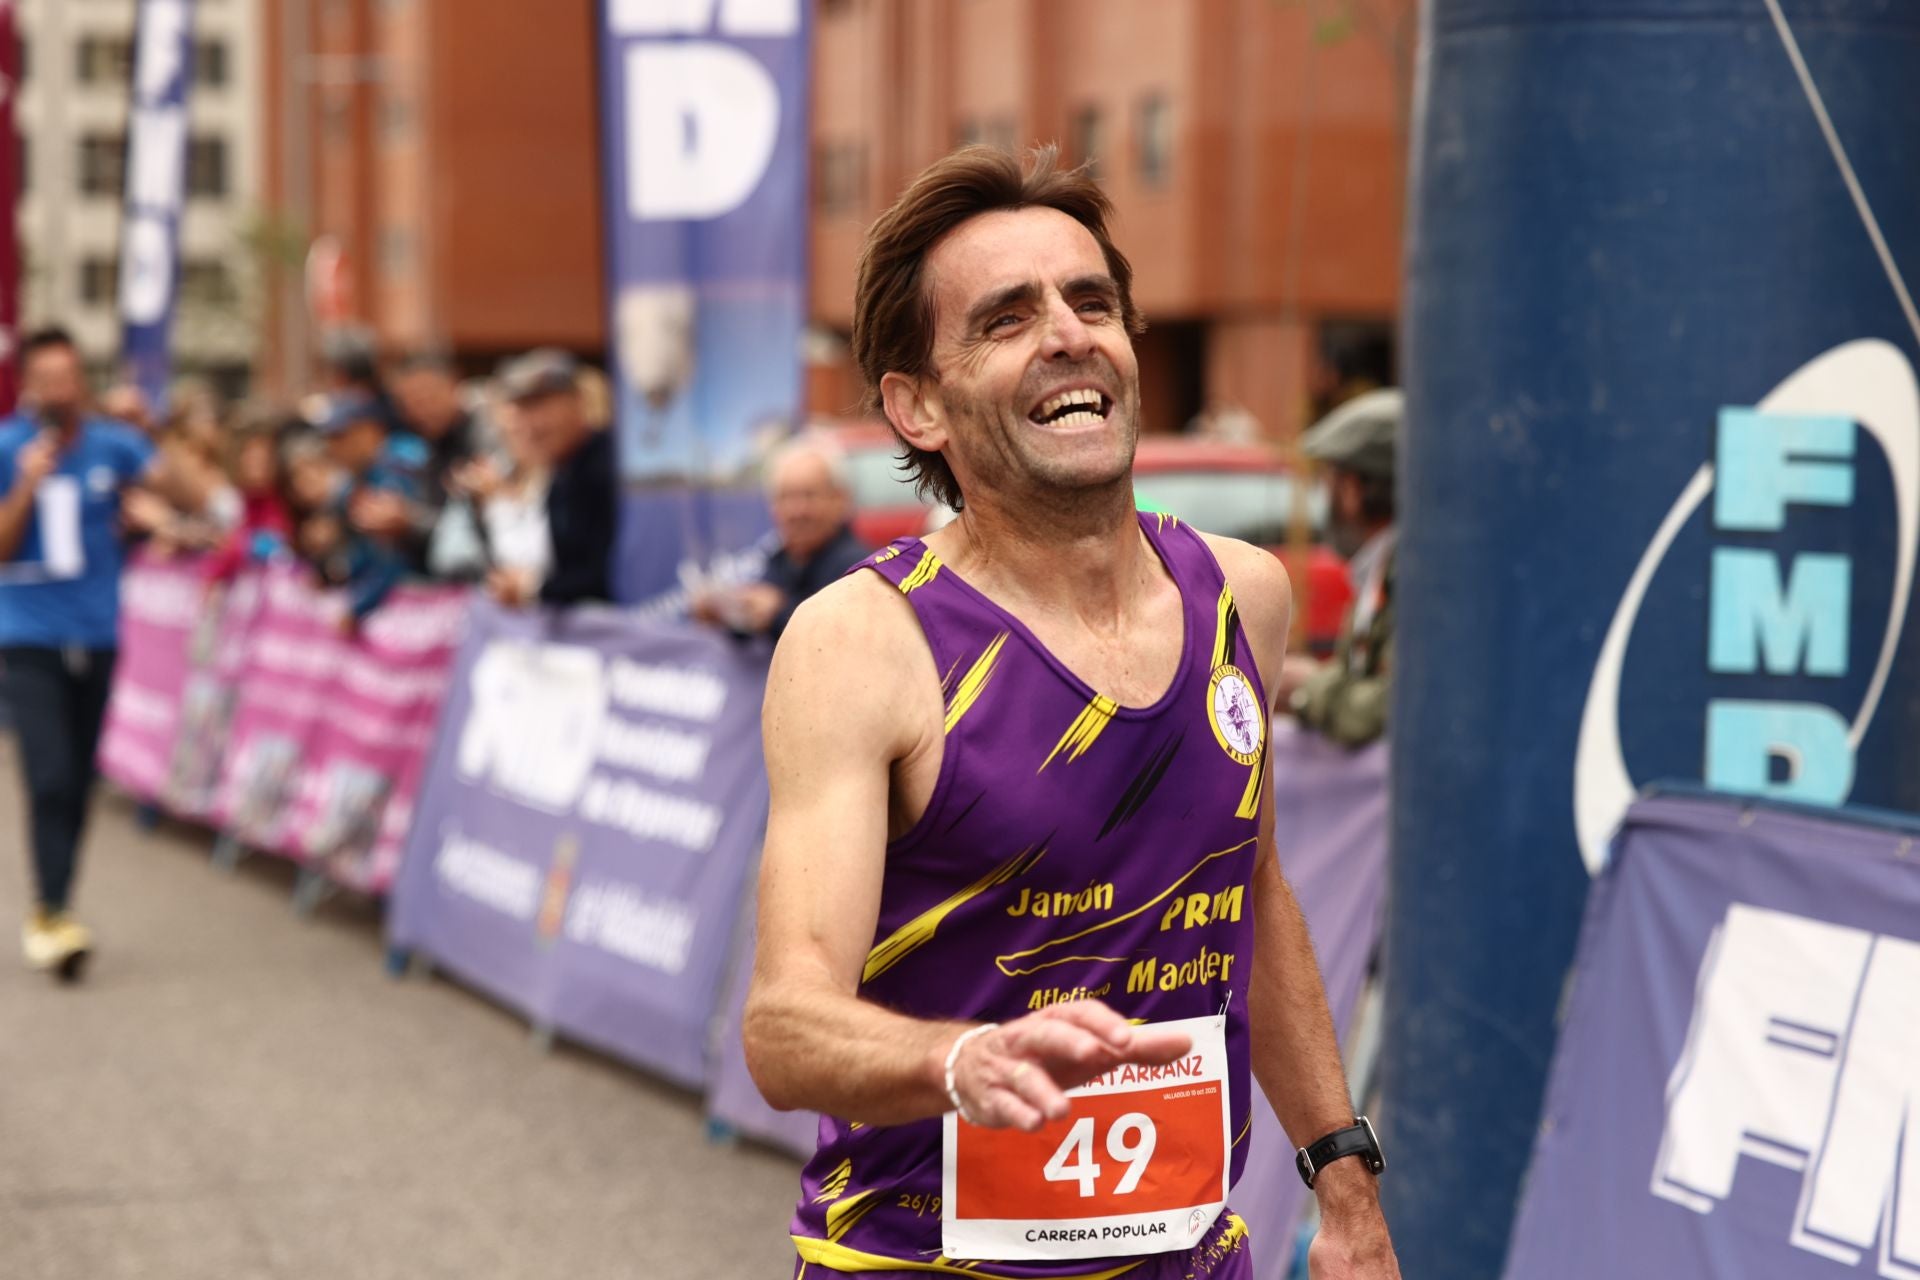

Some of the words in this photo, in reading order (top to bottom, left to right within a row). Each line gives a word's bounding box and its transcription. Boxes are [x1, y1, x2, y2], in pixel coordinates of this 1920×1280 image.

[1706, 406, 1857, 808] FMD
[1006, 879, 1114, 918] Jamón
[1160, 884, 1244, 931] PRM
[1043, 1112, 1157, 1198] 49
[1025, 1229, 1098, 1242] CARRERA
[1102, 1222, 1167, 1240] POPULAR
